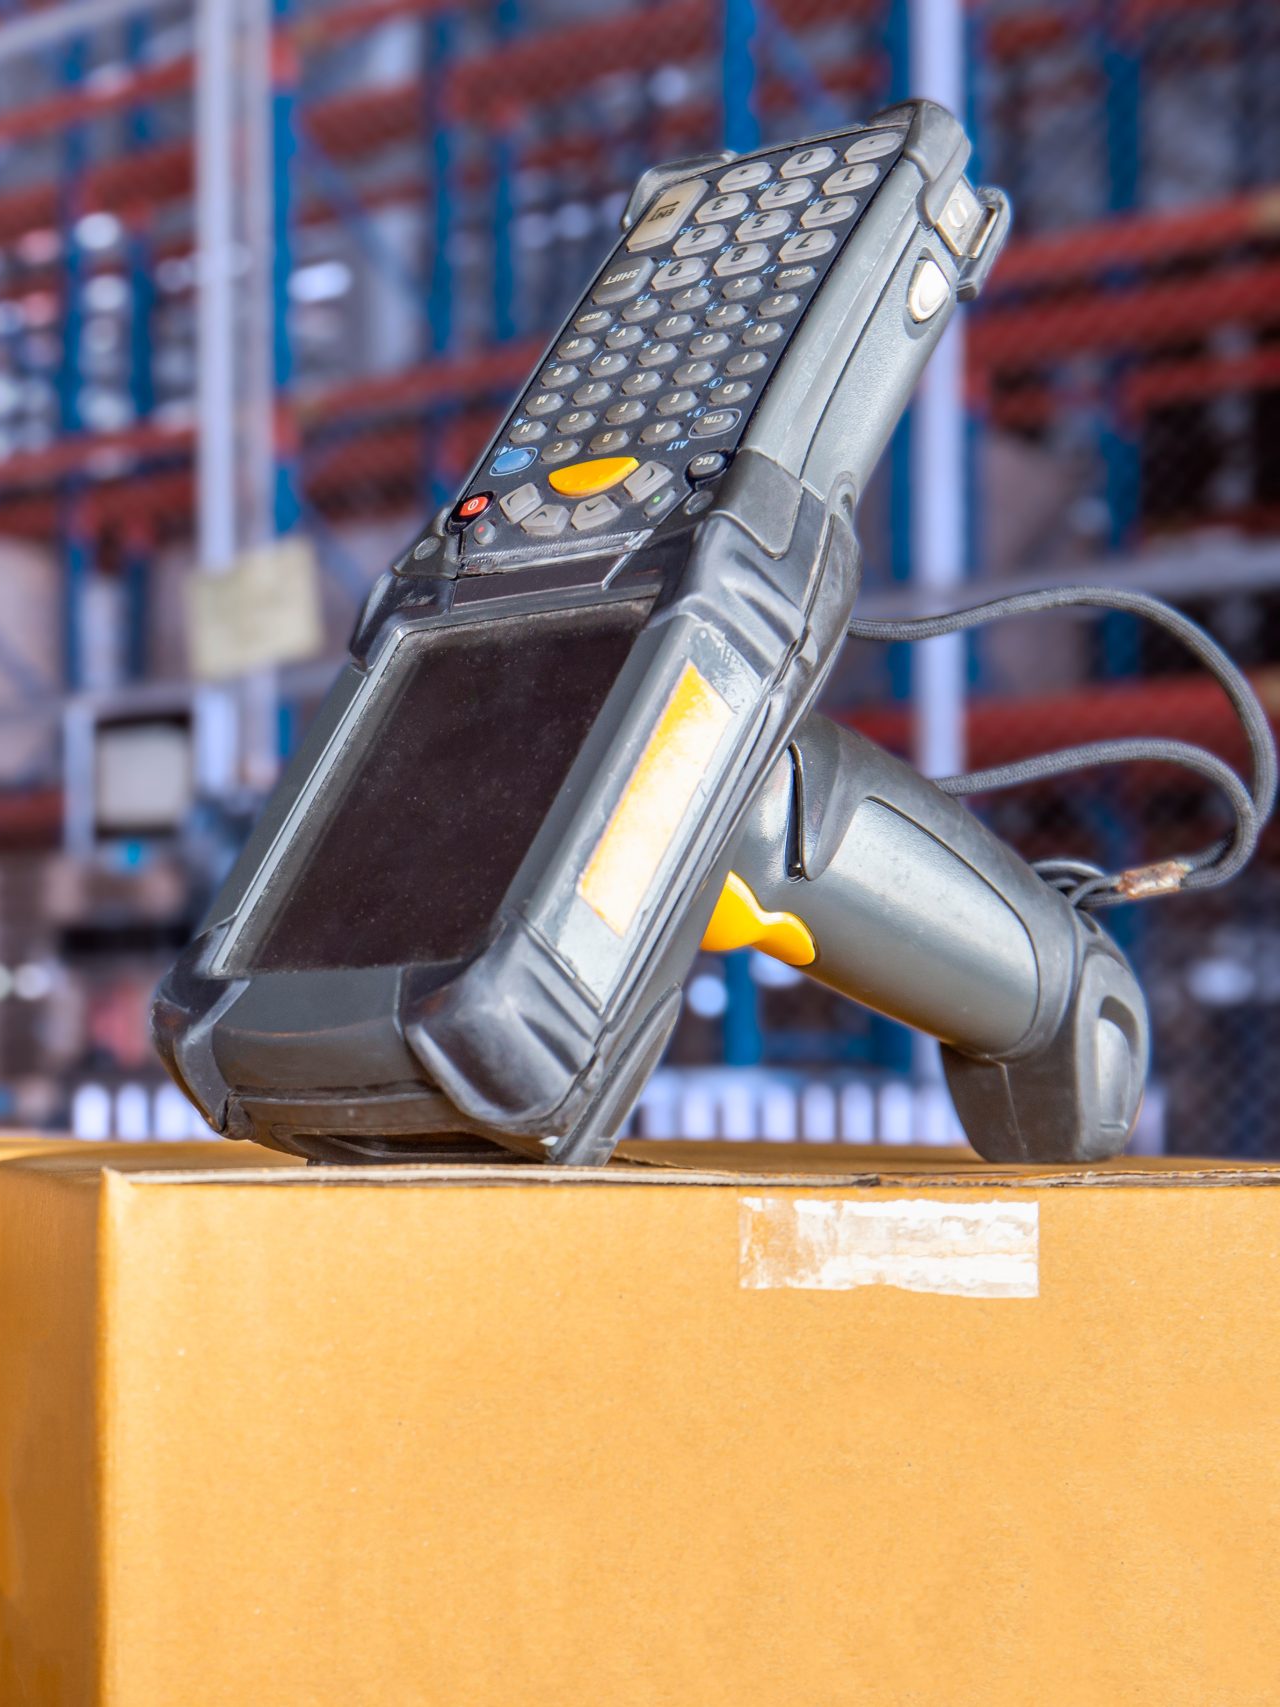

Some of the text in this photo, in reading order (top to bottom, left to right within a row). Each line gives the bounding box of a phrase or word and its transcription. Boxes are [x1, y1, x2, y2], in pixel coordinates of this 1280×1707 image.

[843, 168, 855, 182] 1
[774, 182, 792, 197] 2
[712, 197, 729, 211] 3
[820, 200, 837, 214] 4
[752, 213, 770, 229] 5
[692, 228, 706, 243] 6
[795, 233, 815, 250] 7
[731, 246, 748, 262] 8
[668, 262, 683, 276] 9
[780, 266, 810, 278] SPACE
[602, 268, 641, 285] SHIFT
[734, 278, 747, 288] X
[682, 289, 693, 299] Y
[773, 295, 784, 305] S
[633, 301, 645, 311] Z
[718, 306, 728, 316] T
[666, 316, 678, 327] U
[616, 328, 627, 338] V
[754, 324, 768, 335] N
[566, 339, 580, 350] W
[650, 344, 661, 355] P
[600, 356, 612, 366] Q
[553, 367, 563, 377] R
[687, 363, 697, 373] J
[634, 373, 646, 384] K
[587, 384, 595, 394] L
[722, 384, 735, 394] D
[536, 394, 550, 405] M
[670, 393, 680, 403] E
[618, 403, 629, 413] F
[568, 413, 579, 423] G
[703, 414, 724, 425] CTRL
[520, 423, 531, 434] H
[655, 423, 666, 434] A
[602, 433, 613, 443] B
[553, 442, 563, 452] C
[666, 440, 690, 451] ALT
[696, 456, 716, 466] ESC
